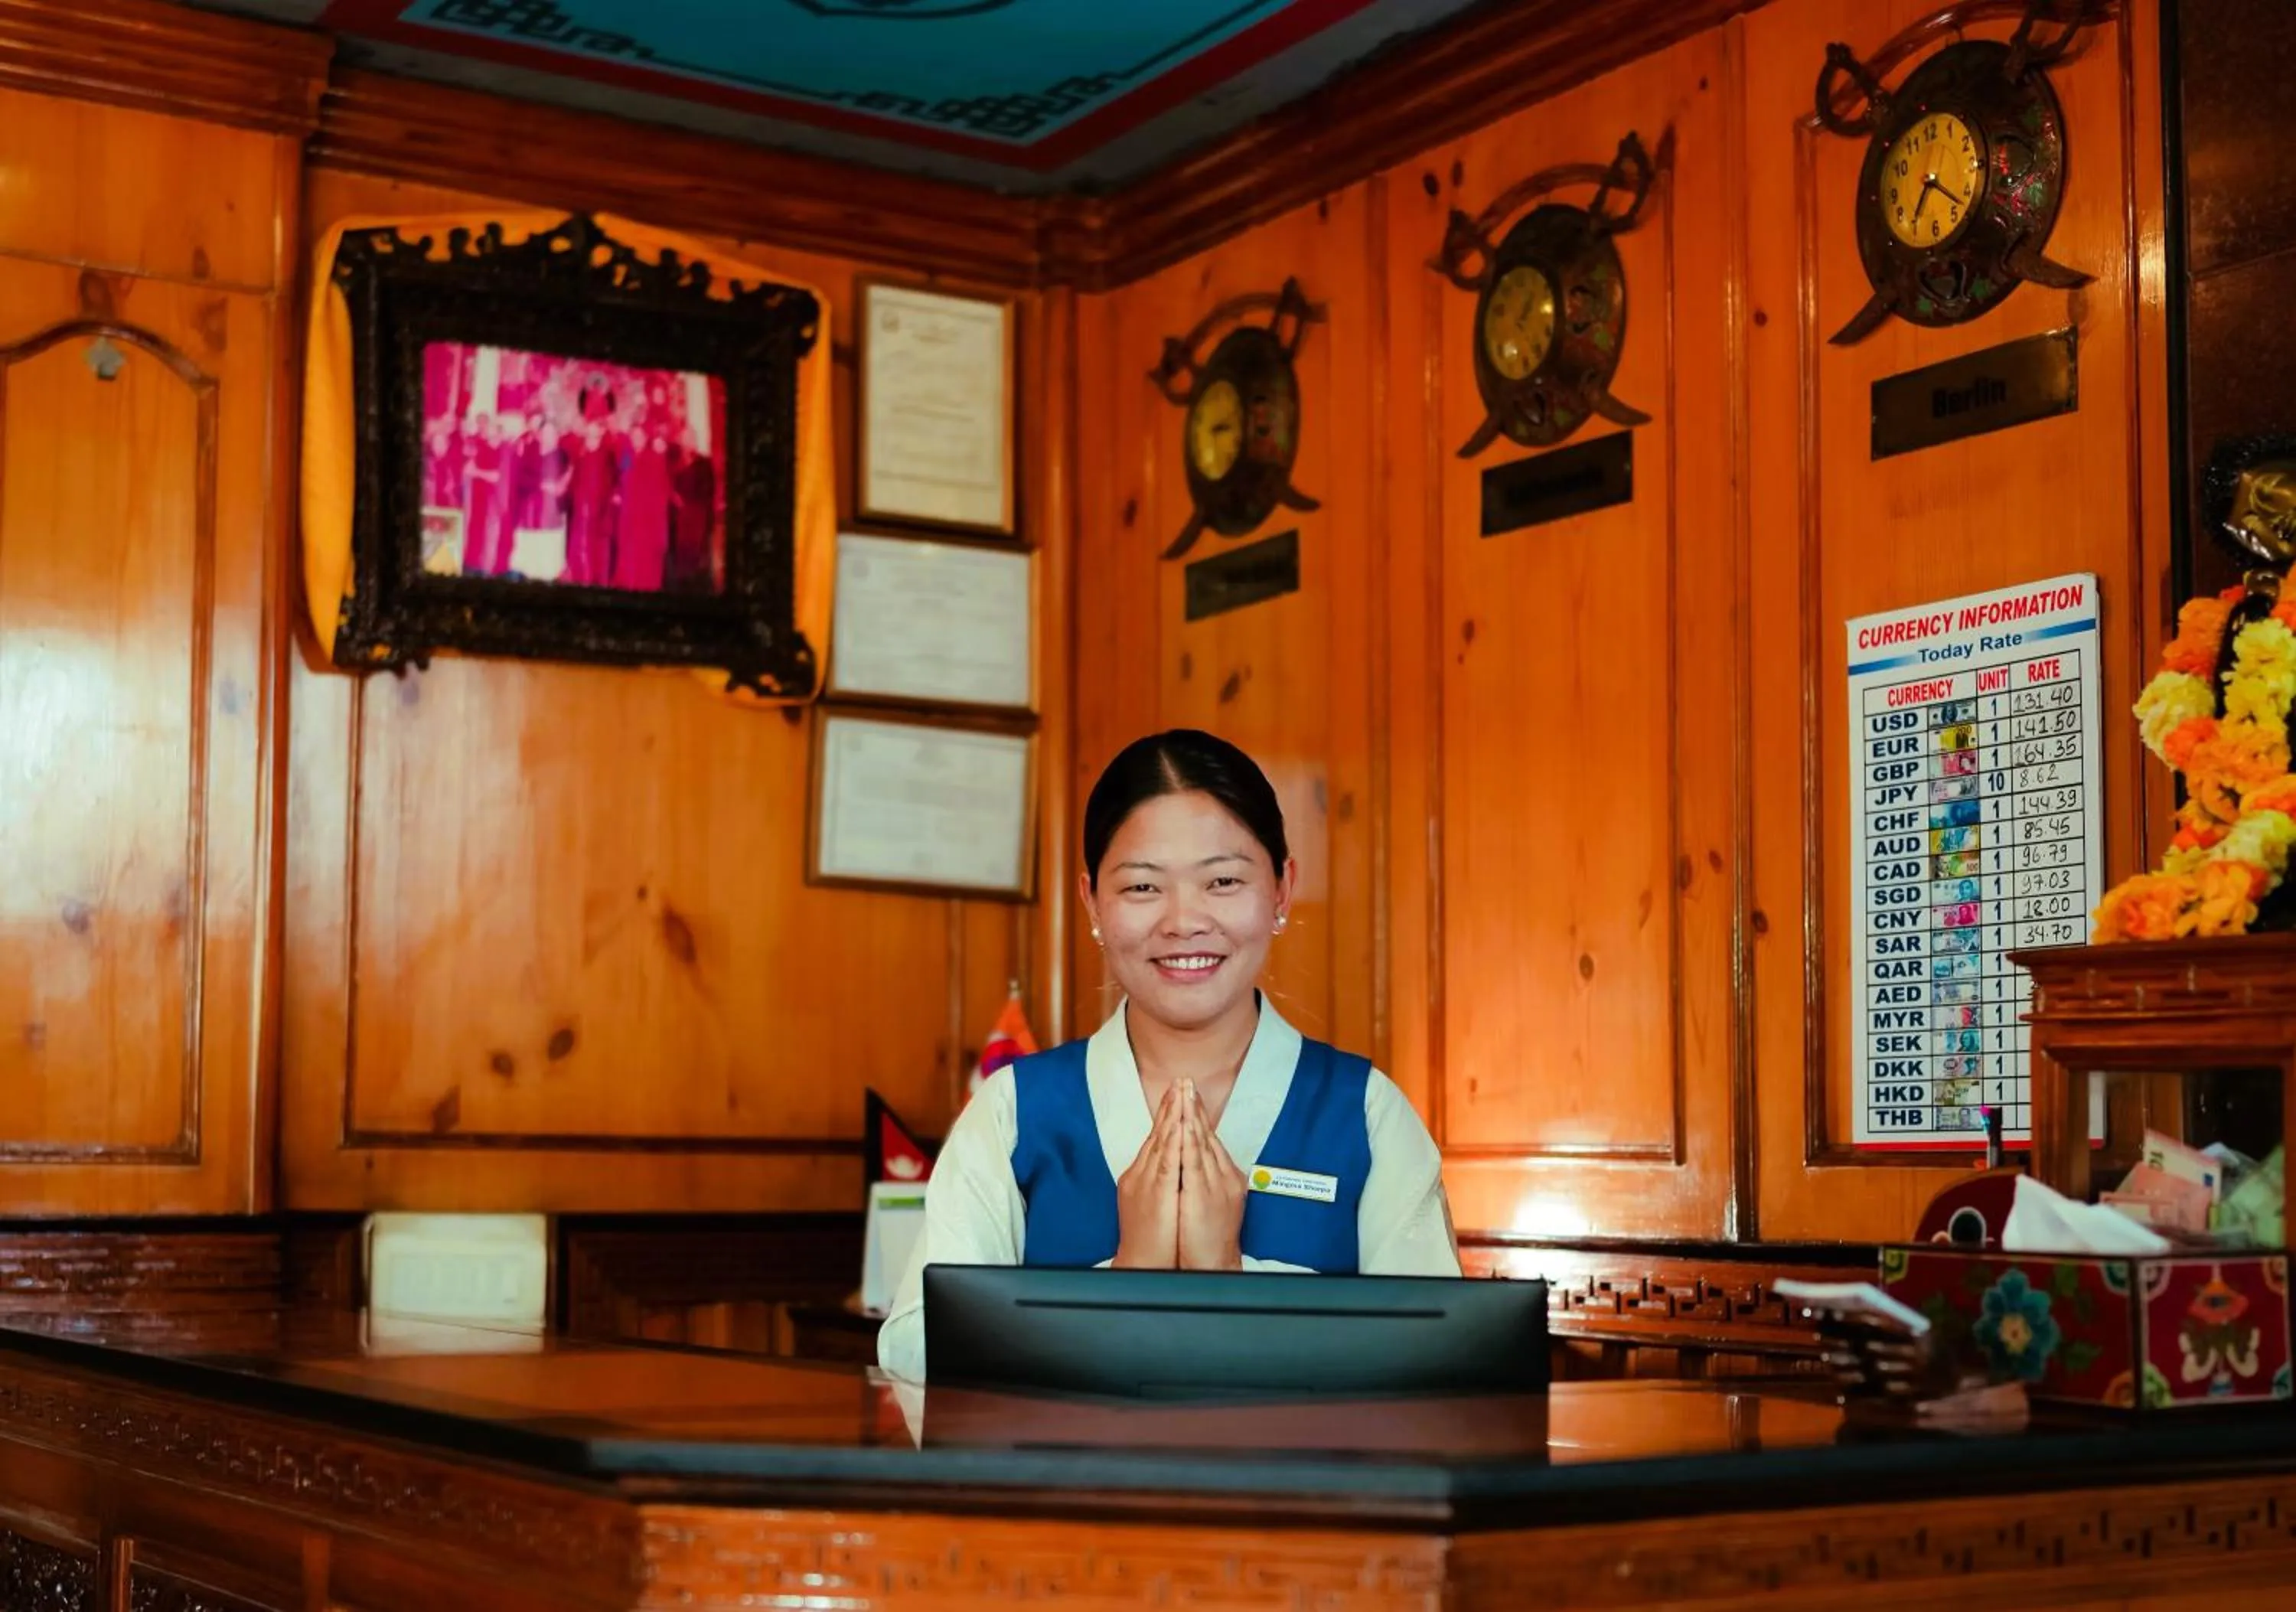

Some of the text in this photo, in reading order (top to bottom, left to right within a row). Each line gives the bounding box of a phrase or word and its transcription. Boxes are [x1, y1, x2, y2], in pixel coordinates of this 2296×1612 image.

[1923, 122, 1937, 142] 12
[1947, 122, 1953, 139] 1
[1962, 135, 1971, 152] 2
[1906, 136, 1919, 155] 11
[1894, 159, 1909, 178] 10
[1932, 376, 2006, 418] Berlin
[1858, 585, 2083, 650] CURRENCY INFORMATION
[1919, 633, 2022, 663] Today Rate
[1888, 659, 2060, 706] CURRENCY UNIT RATE
[2014, 686, 2073, 713] 131.40
[1872, 697, 1997, 733] USD 1
[2014, 710, 2076, 739] 141.50
[1872, 723, 1998, 758] EUR 1
[1873, 748, 1998, 783] GBP 1
[1874, 772, 2004, 806] JPY 10
[1874, 800, 1999, 831] CHF 1
[1874, 824, 2000, 857] AUD 1
[1874, 850, 2000, 881] CAD 1
[1874, 876, 2001, 906] SGD 1
[1874, 902, 2001, 930] CNY 1
[1875, 927, 2001, 954] SAR 1
[2024, 923, 2073, 944] 34.70
[1874, 953, 2002, 980] QAR 1
[1875, 979, 2002, 1004] AED 1
[1874, 1005, 2003, 1030] MYR 1
[1875, 1030, 2003, 1054] SEK 1
[1874, 1056, 2003, 1078] DKK 1
[1874, 1082, 2003, 1103] HKD 1
[1875, 1110, 1923, 1127] THB
